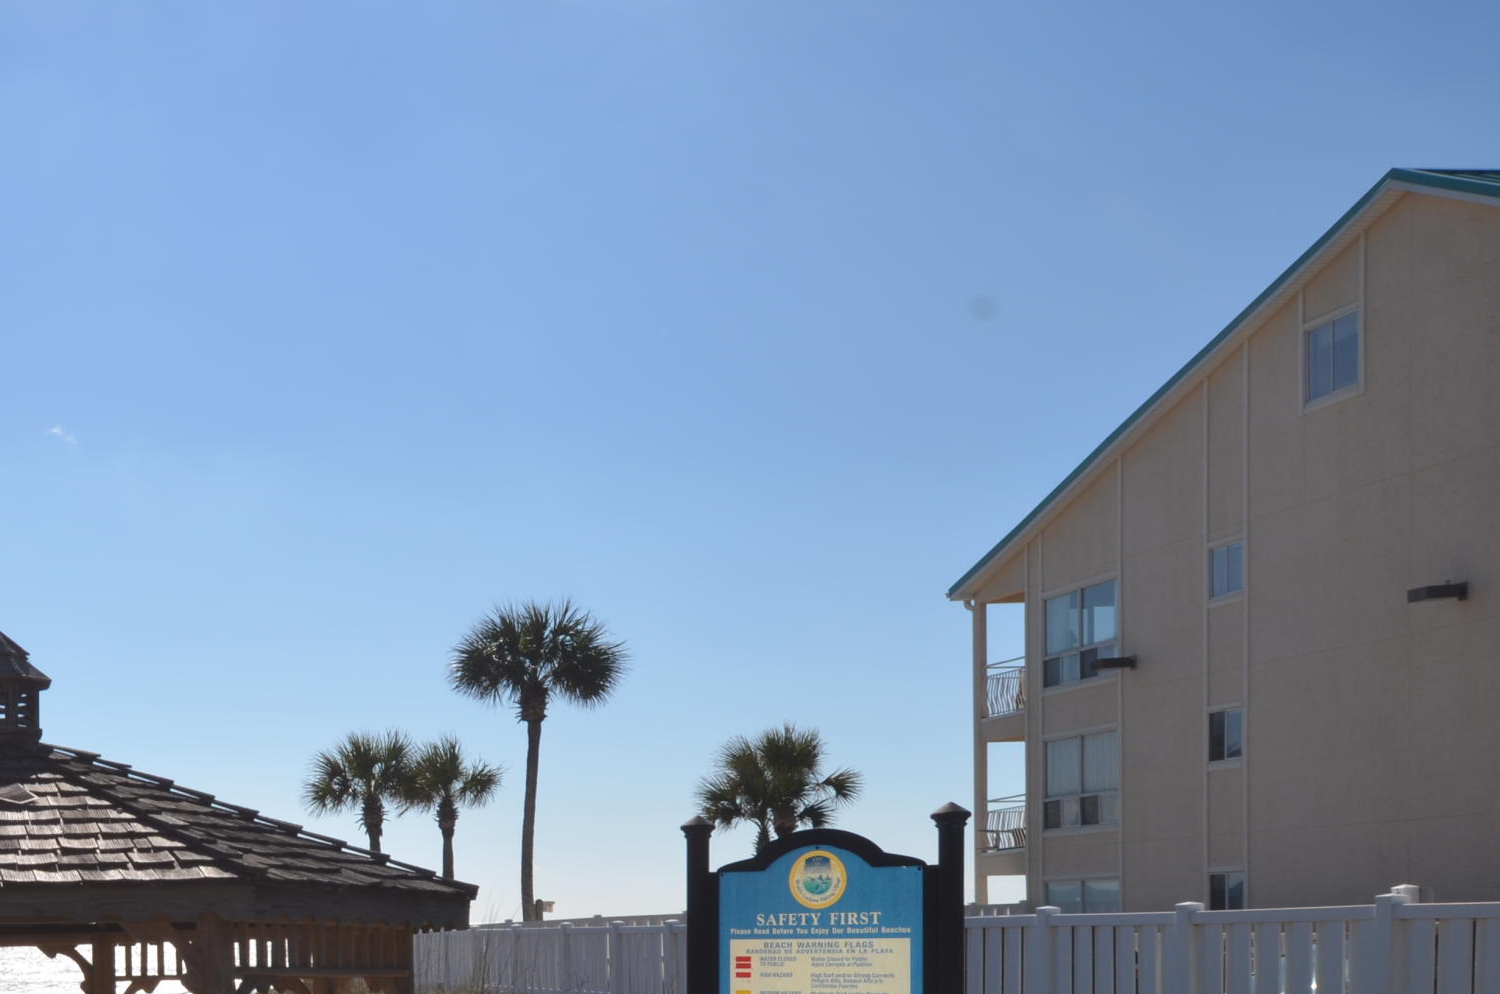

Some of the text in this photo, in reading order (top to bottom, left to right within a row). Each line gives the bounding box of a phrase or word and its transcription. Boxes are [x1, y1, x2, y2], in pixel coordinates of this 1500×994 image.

[756, 912, 882, 926] SAFETY FIRST
[810, 927, 829, 936] Enjoy
[846, 926, 879, 934] Beautiful
[881, 926, 911, 934] Beaches
[763, 941, 875, 949] BEACH WARNING FLAGS
